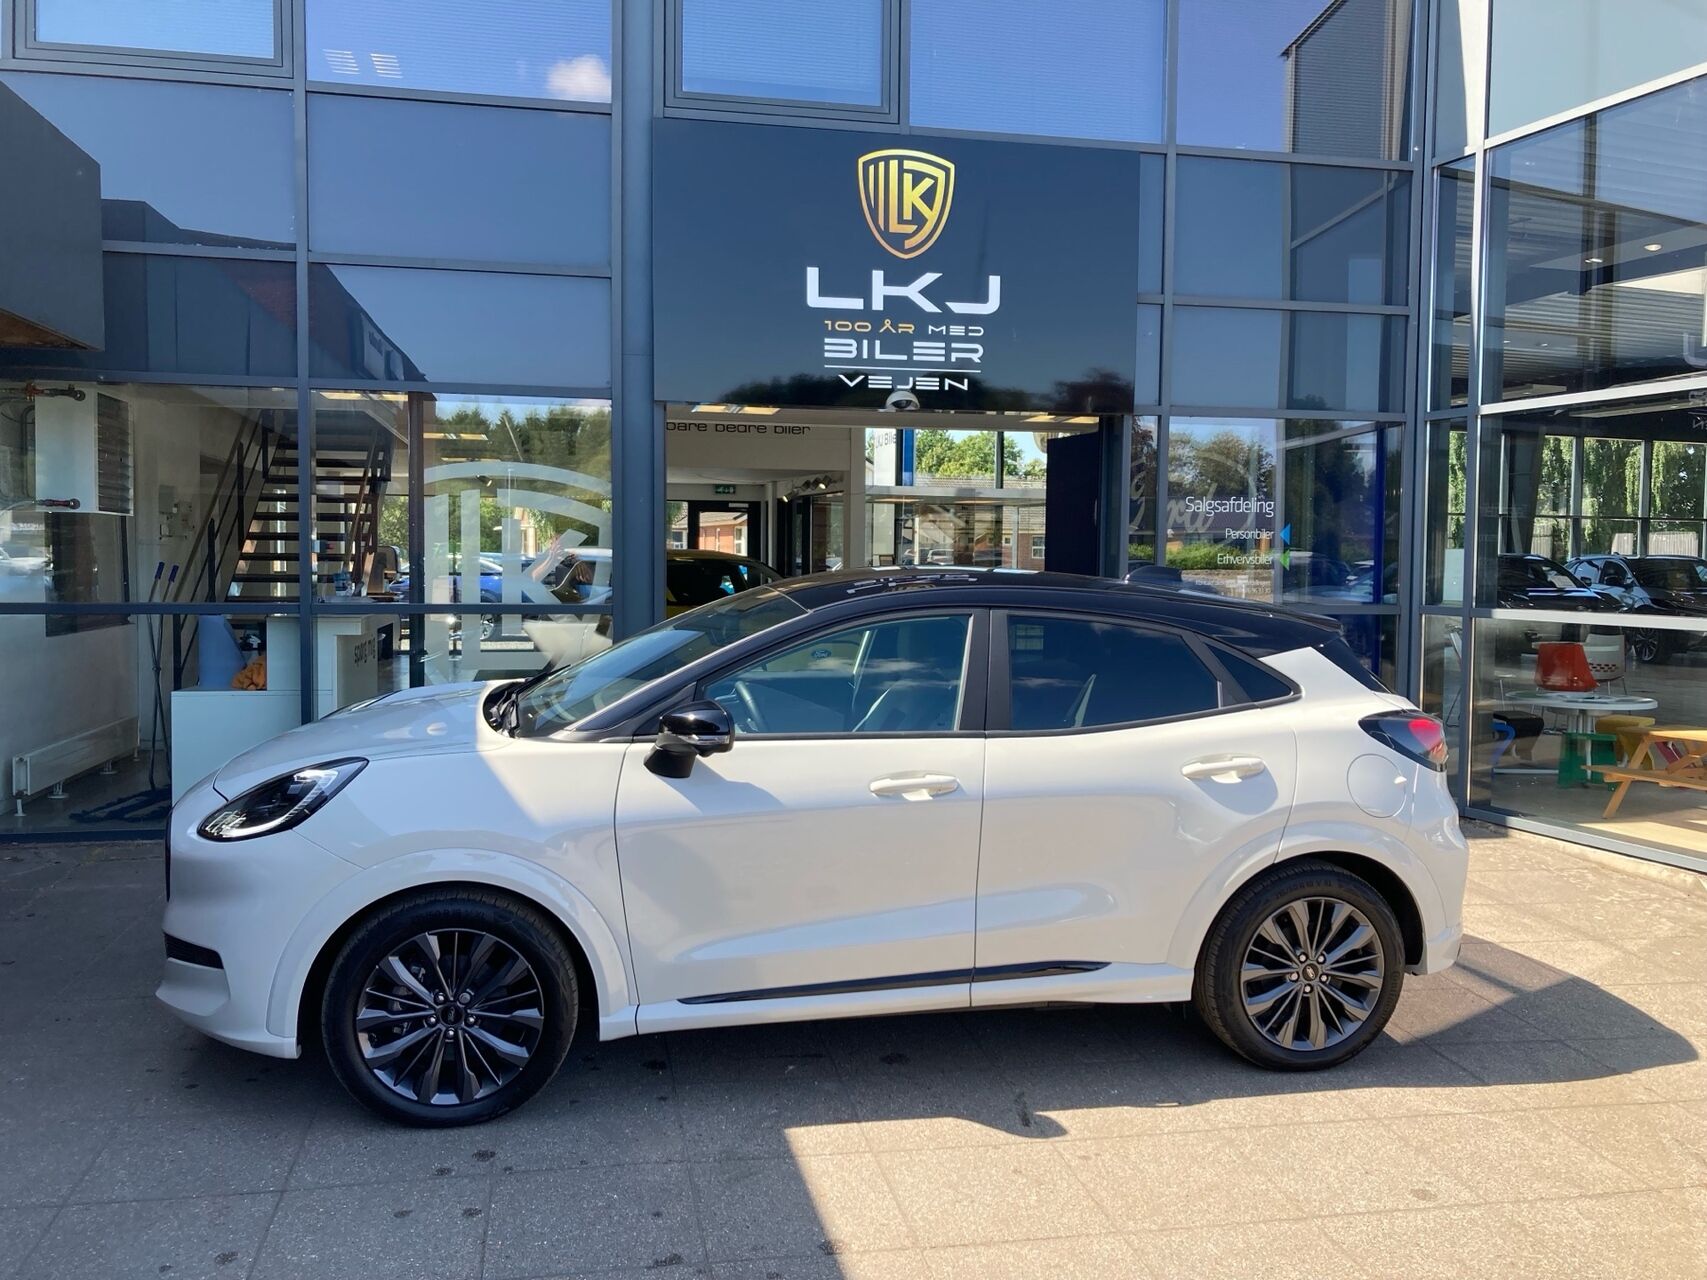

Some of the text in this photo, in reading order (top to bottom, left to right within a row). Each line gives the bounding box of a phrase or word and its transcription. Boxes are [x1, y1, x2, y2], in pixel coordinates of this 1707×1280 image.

[806, 266, 1001, 315] LKJ
[824, 319, 984, 337] 100 ÅR MED
[824, 337, 984, 363] BILER
[838, 374, 968, 391] VEJEN
[1185, 496, 1275, 518] Salgsafdeling
[1225, 527, 1274, 541] Personbiler
[1217, 553, 1273, 565] Erhvervsbiler
